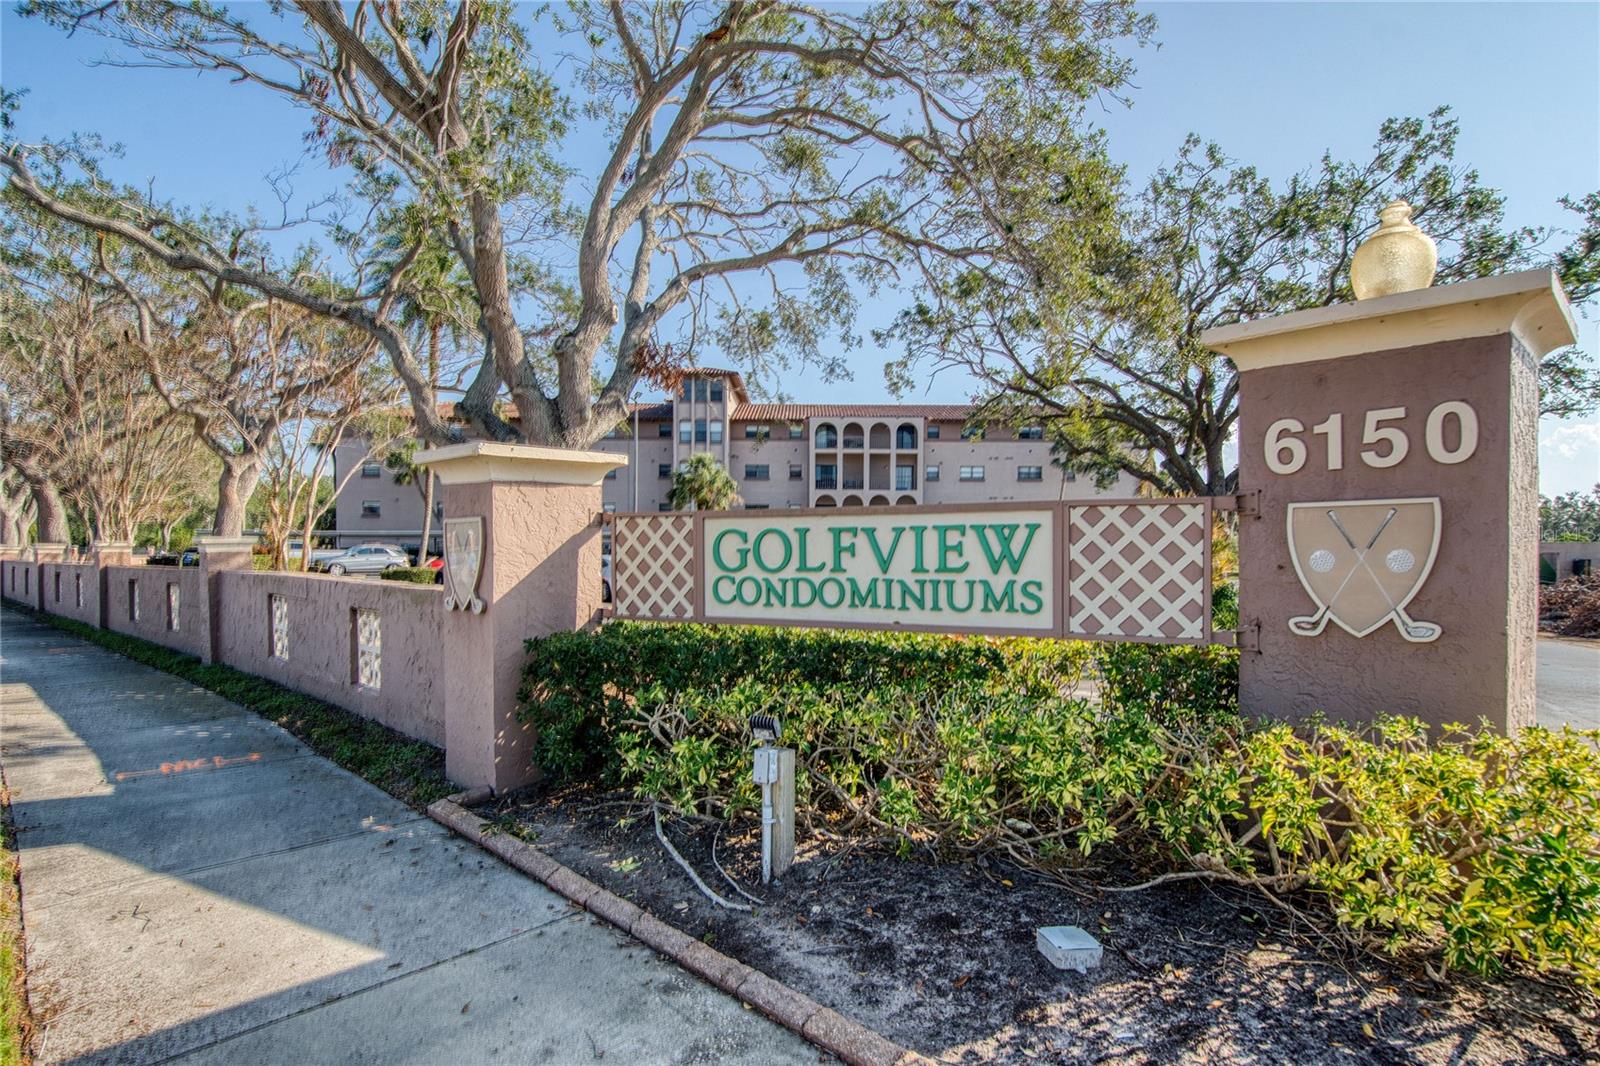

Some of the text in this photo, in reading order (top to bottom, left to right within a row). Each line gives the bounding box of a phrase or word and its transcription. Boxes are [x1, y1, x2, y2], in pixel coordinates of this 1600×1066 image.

[1264, 400, 1479, 475] 6150
[711, 523, 1041, 574] GOLFVIEW
[711, 574, 1043, 615] CONDOMINIUMS
